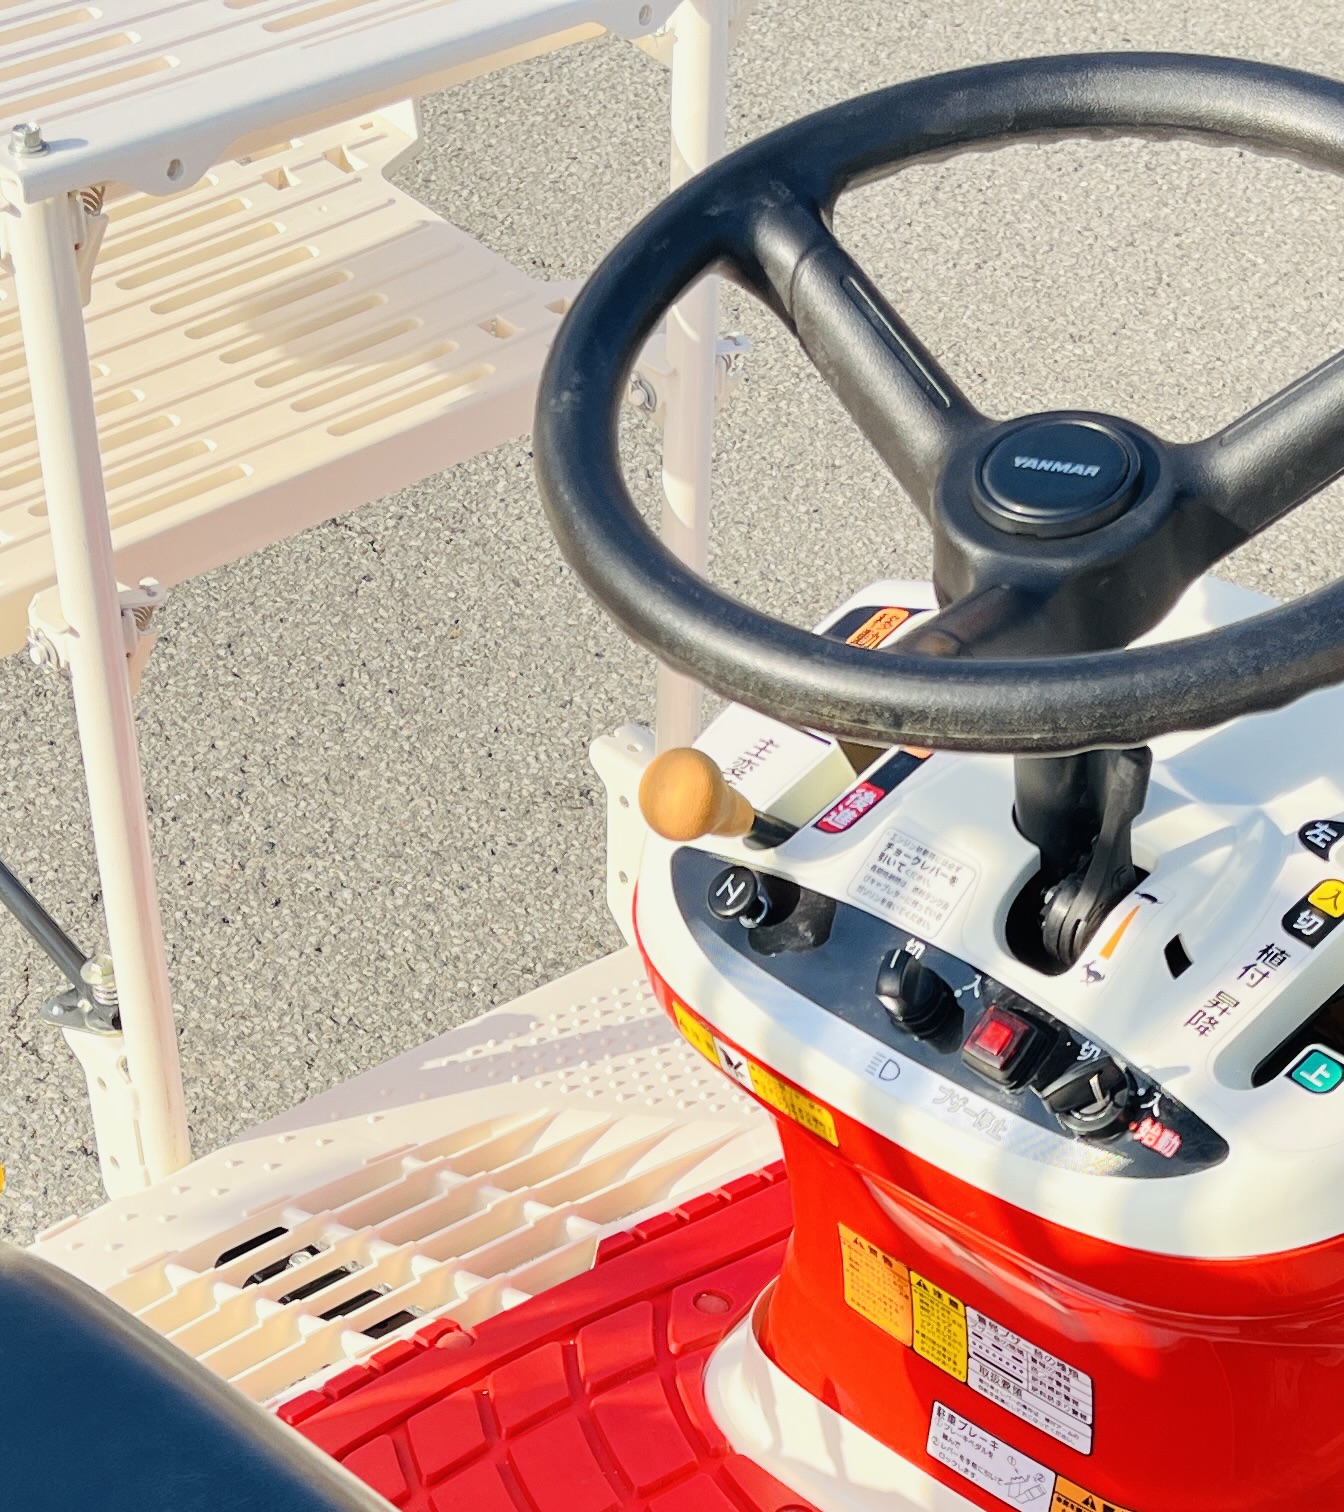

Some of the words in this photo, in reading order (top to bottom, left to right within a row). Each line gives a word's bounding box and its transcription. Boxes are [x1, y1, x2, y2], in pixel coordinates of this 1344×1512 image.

[1014, 456, 1101, 477] YANMAR
[822, 788, 877, 829] 後進
[1305, 823, 1338, 849] 左
[1292, 910, 1325, 936] 切
[905, 937, 926, 959] 切
[1237, 943, 1291, 988] 植付
[962, 974, 982, 998] 入
[1183, 990, 1241, 1037] 昇降
[1077, 1040, 1102, 1061] 切
[1300, 1063, 1332, 1087] 上
[1140, 1092, 1162, 1117] 入
[1132, 1116, 1182, 1158] 始動
[937, 1406, 999, 1451] 駐車ブレーキ
